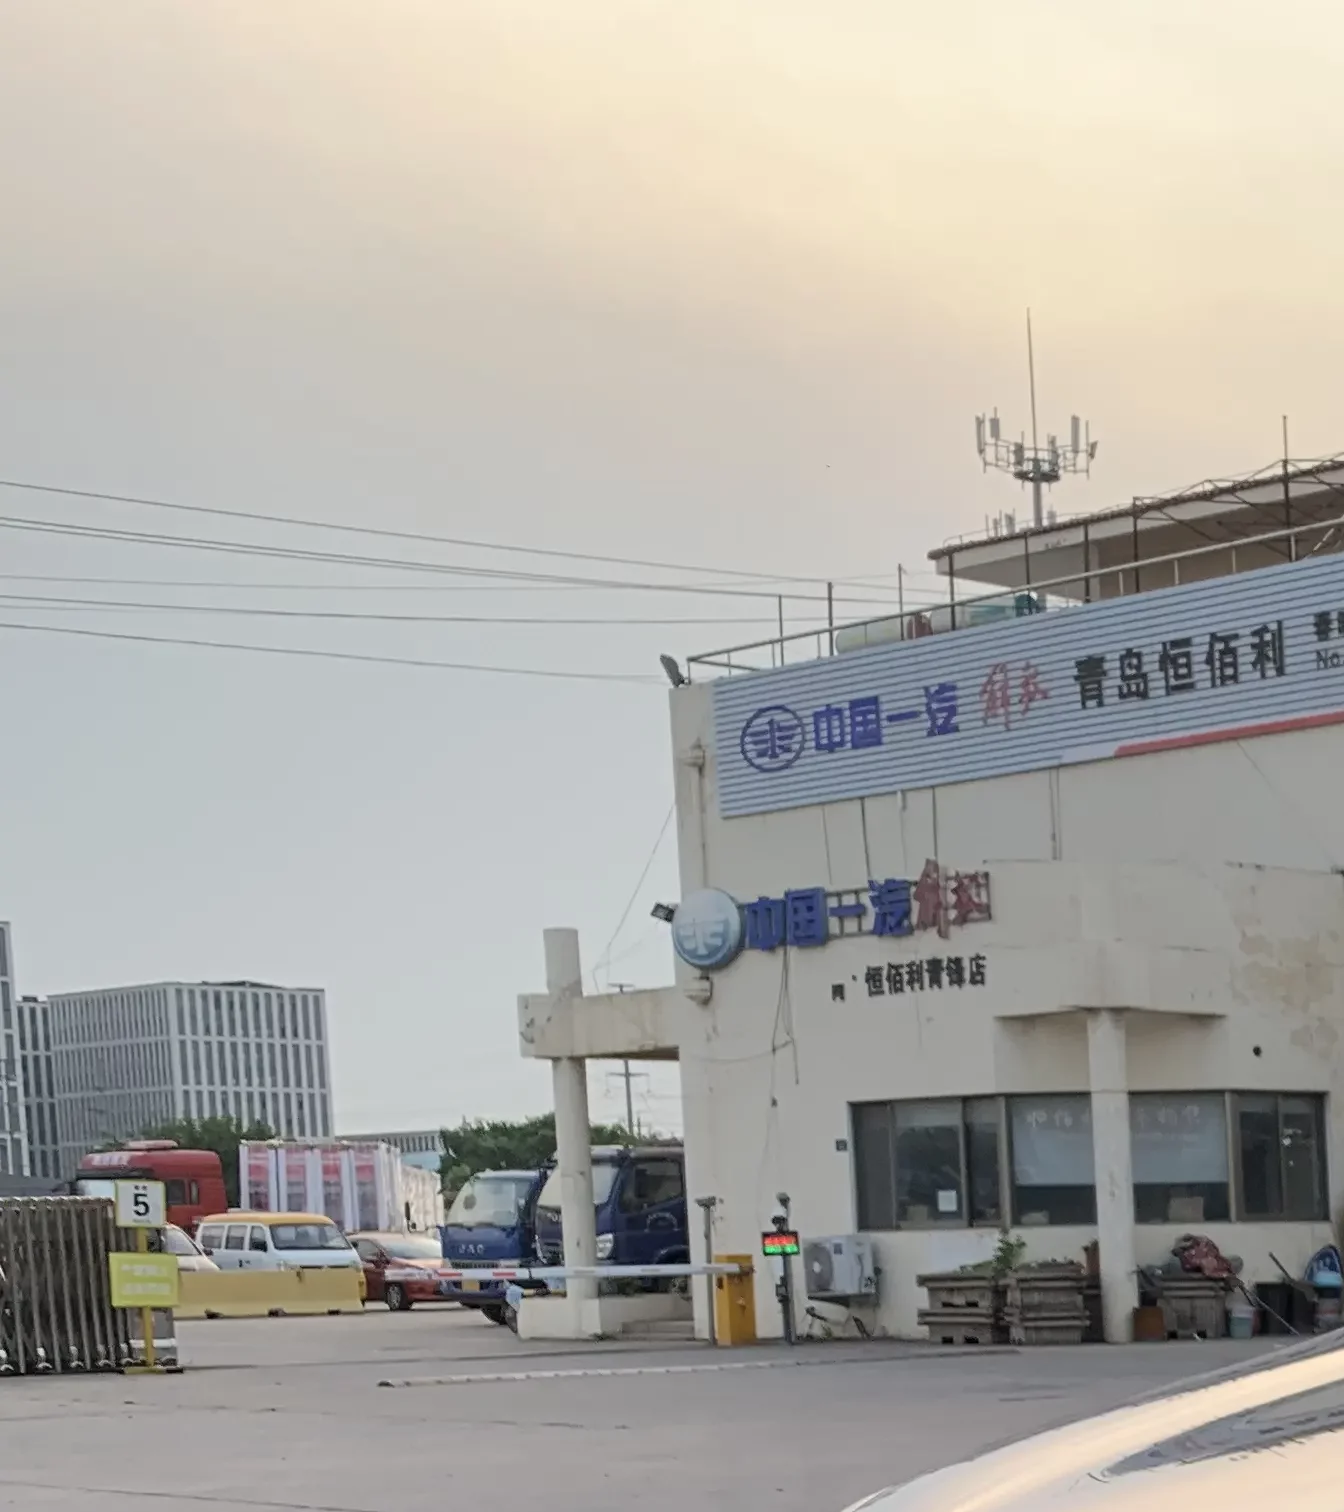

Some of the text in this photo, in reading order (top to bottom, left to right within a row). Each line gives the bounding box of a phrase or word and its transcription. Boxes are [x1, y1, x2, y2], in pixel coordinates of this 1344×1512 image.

[812, 683, 961, 754] 中国一汽
[1073, 619, 1287, 710] 青岛恒佰利
[133, 1193, 150, 1217] 5
